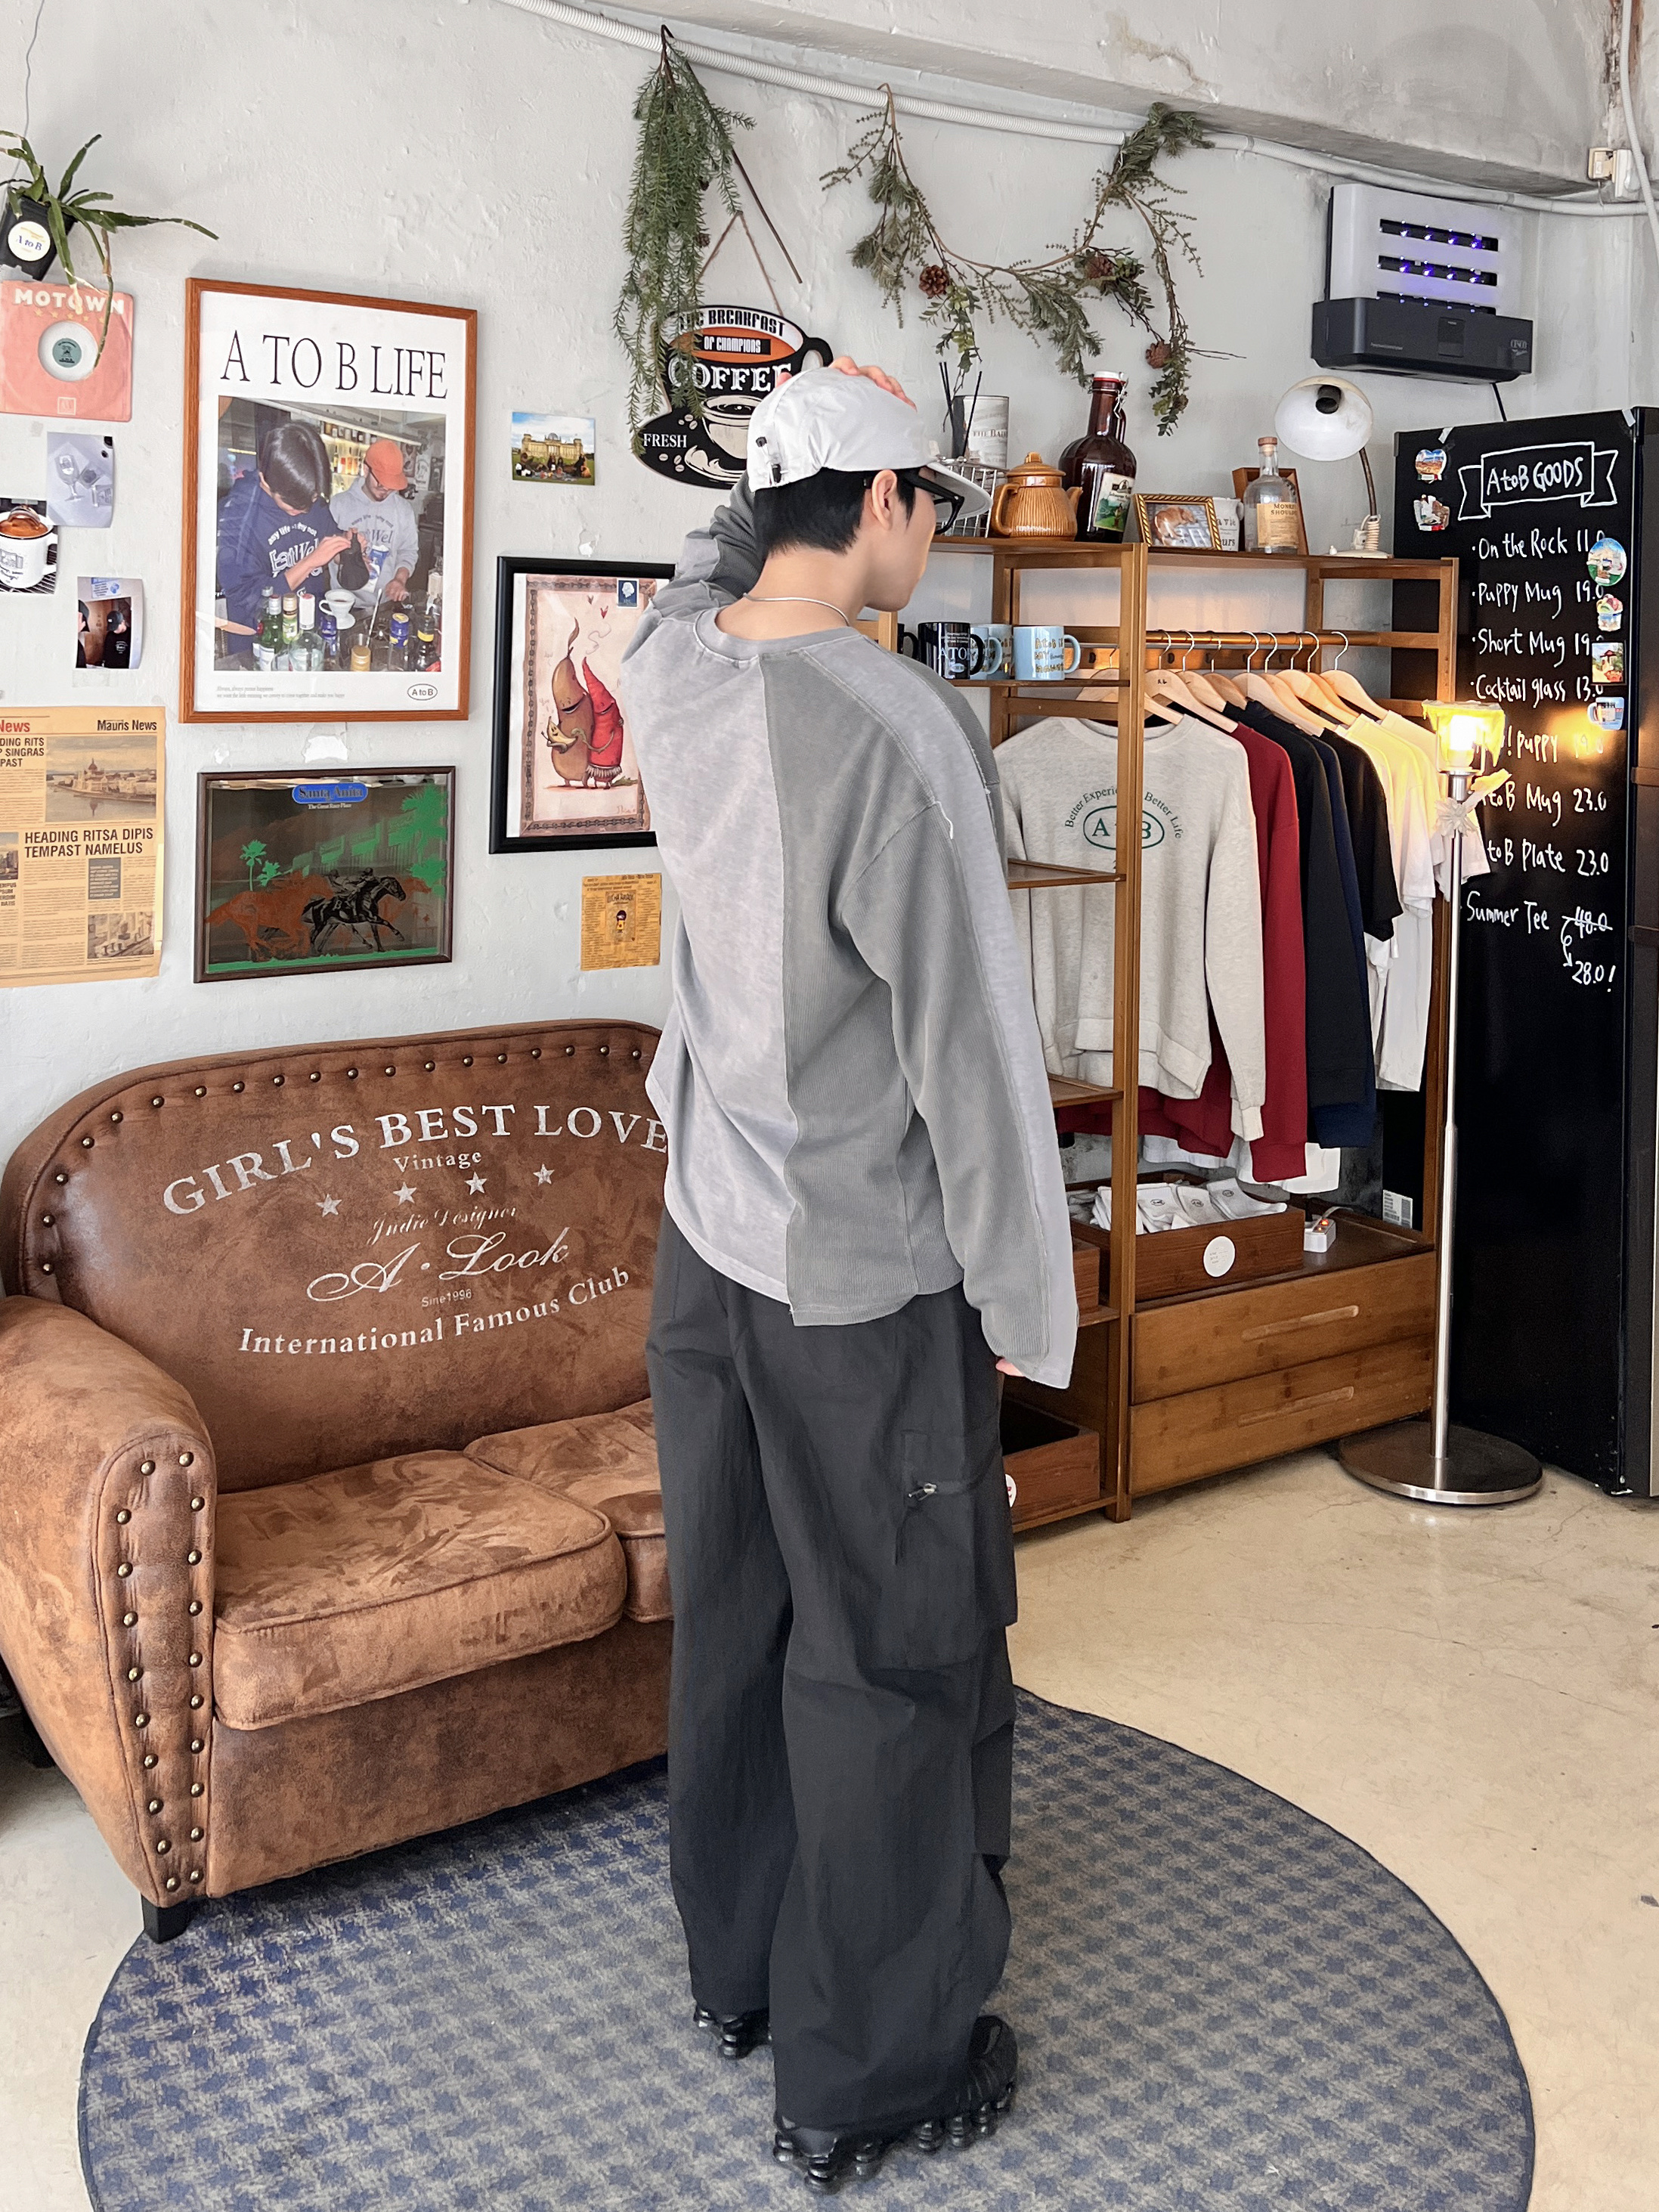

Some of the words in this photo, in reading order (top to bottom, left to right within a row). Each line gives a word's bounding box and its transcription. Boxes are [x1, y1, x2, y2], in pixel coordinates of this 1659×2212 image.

[25, 239, 34, 247] to
[35, 241, 42, 251] B
[14, 288, 125, 314] MOTOWN
[708, 309, 785, 337] BREAKFAST
[220, 330, 250, 382] A
[262, 334, 322, 388] TO
[335, 342, 357, 391] B
[370, 345, 447, 399] LIFE
[643, 433, 688, 448] FRESH
[1533, 457, 1584, 493] GOODS
[1221, 538, 1236, 547] urs
[1478, 538, 1499, 559] On
[1503, 532, 1527, 558] the
[1531, 527, 1568, 559] Rock
[1525, 581, 1562, 620] Mug
[1478, 627, 1523, 656] Short
[1529, 631, 1565, 668] Mug
[1575, 633, 1605, 655] 19
[1476, 674, 1526, 703] Cocktail
[1531, 678, 1566, 708] glass
[97, 720, 129, 731] Mauris
[132, 719, 157, 731] News
[5, 748, 45, 757] SINGRAS
[24, 737, 45, 746] RITS
[1064, 799, 1085, 828] Better
[1082, 785, 1118, 804] Experi
[1144, 792, 1173, 816] Better
[1169, 815, 1184, 839] Life
[1526, 782, 1562, 827] Mug
[1573, 788, 1607, 813] 23.0
[25, 830, 79, 844] HEADING
[83, 829, 118, 841] RITSA
[122, 828, 153, 840] DIPIS
[1091, 817, 1110, 837] A
[24, 844, 81, 858] TEMPAST
[85, 842, 143, 856] NAMELUS
[1522, 838, 1566, 872] Plate
[1577, 849, 1609, 877] 23.0
[1467, 891, 1519, 927] Summer
[1524, 900, 1550, 934] Tee
[163, 1124, 360, 1214] GIRL'S
[374, 1104, 515, 1149] BEST
[392, 1150, 482, 1173] Vintage
[239, 1318, 443, 1355] International
[454, 1298, 560, 1337] Famous
[568, 1267, 630, 1306] Club
